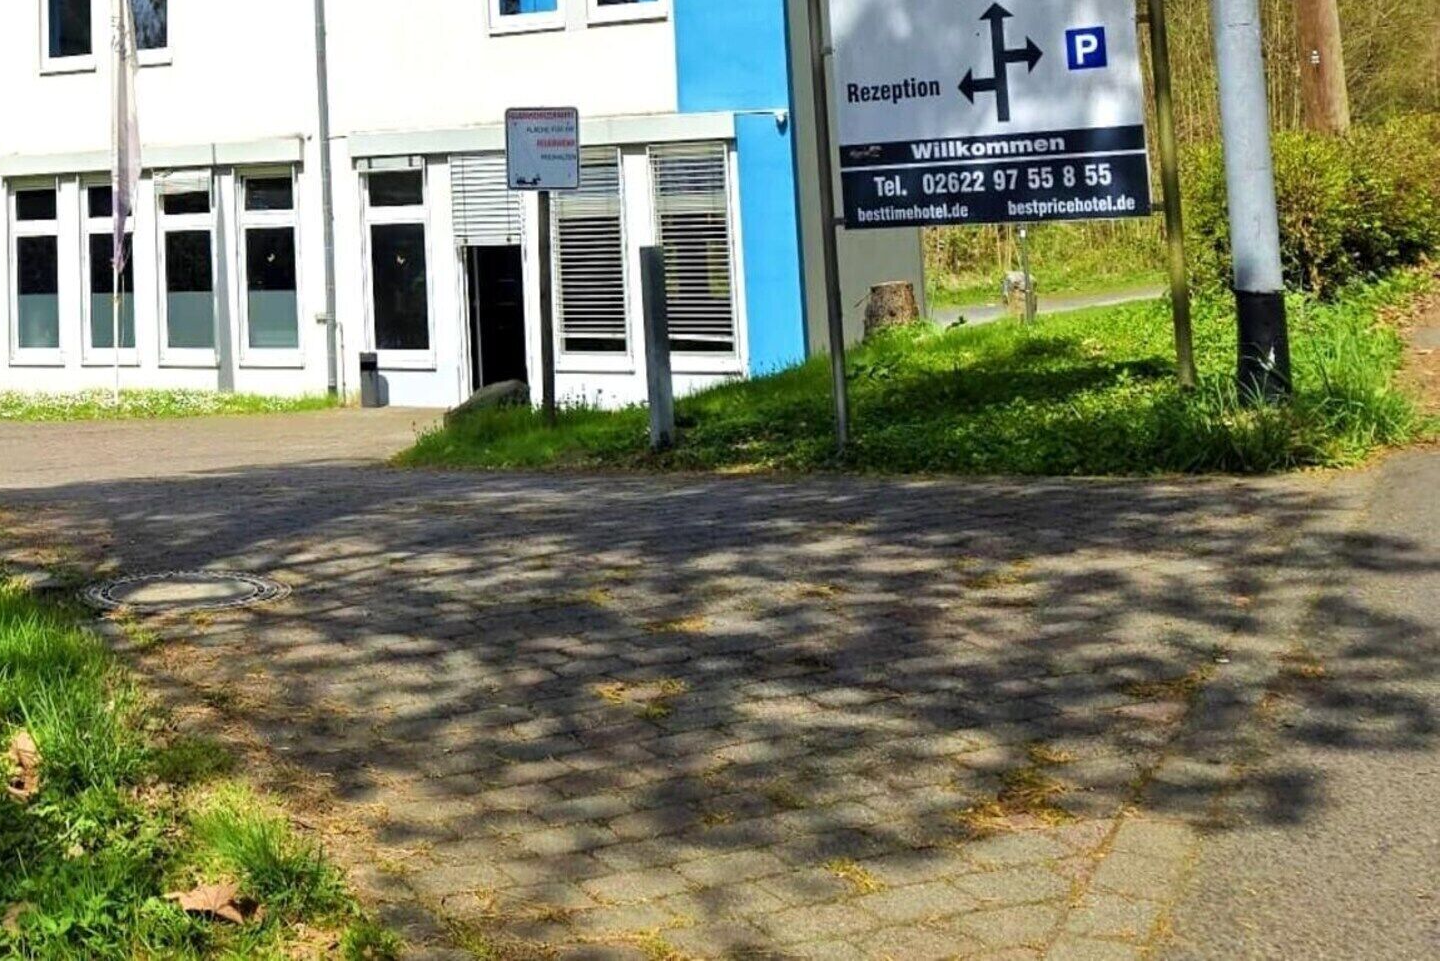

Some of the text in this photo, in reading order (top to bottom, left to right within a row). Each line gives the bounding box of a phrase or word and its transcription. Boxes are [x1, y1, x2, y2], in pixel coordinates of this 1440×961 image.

[1075, 34, 1098, 65] P
[847, 77, 940, 104] Rezeption
[911, 137, 1066, 160] Willkommen
[874, 163, 1112, 197] Tel. 02622 97 55 8 55
[857, 203, 969, 222] besttimehotel.de
[1007, 194, 1136, 216] bestpricehotel.de
